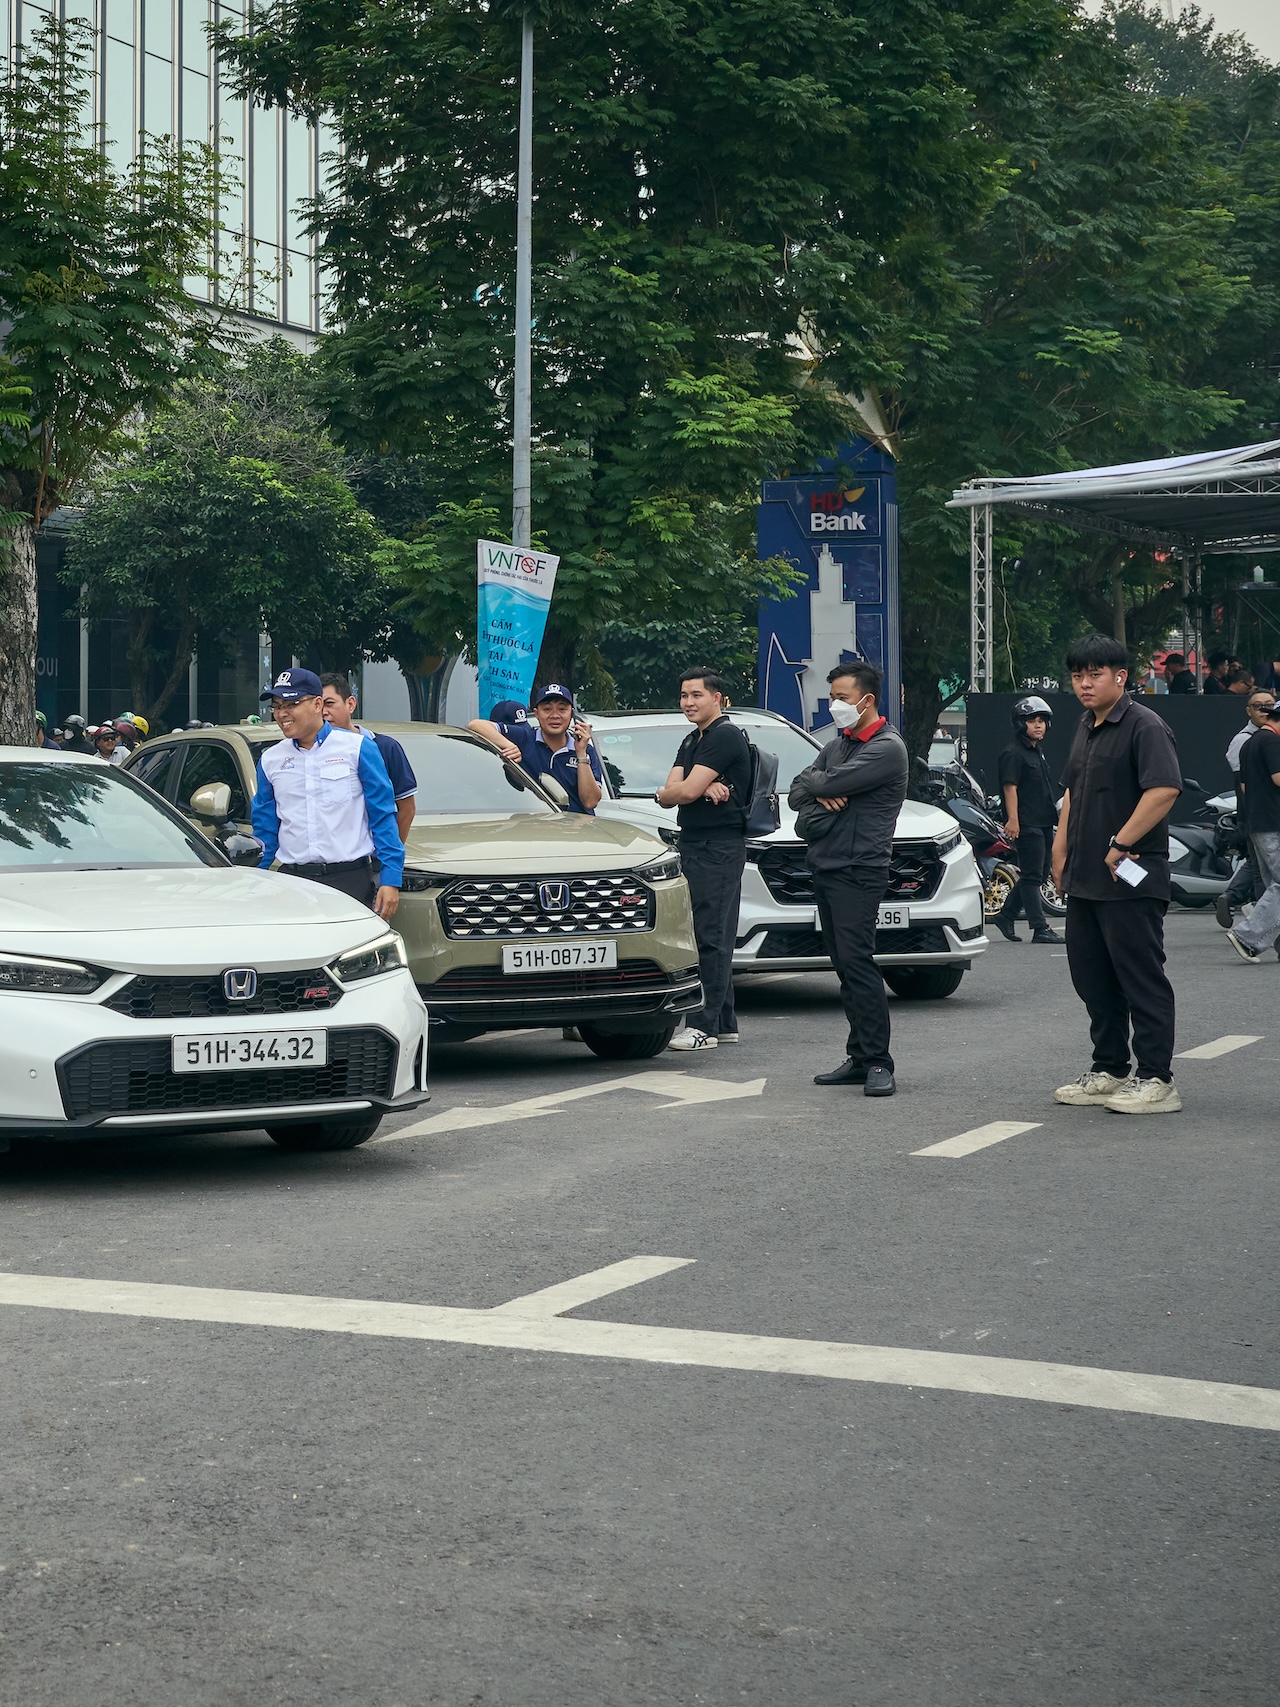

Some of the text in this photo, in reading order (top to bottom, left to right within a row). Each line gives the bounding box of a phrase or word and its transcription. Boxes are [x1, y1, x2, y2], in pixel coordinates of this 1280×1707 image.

[810, 492, 843, 511] HD
[811, 511, 866, 532] Bank
[491, 618, 513, 631] CẤM
[521, 641, 534, 653] LÁ
[500, 669, 520, 681] SẠN
[620, 895, 641, 905] RS
[513, 946, 607, 968] 51H-087.37
[303, 987, 330, 999] RS
[186, 1037, 314, 1065] 51H-344.32
